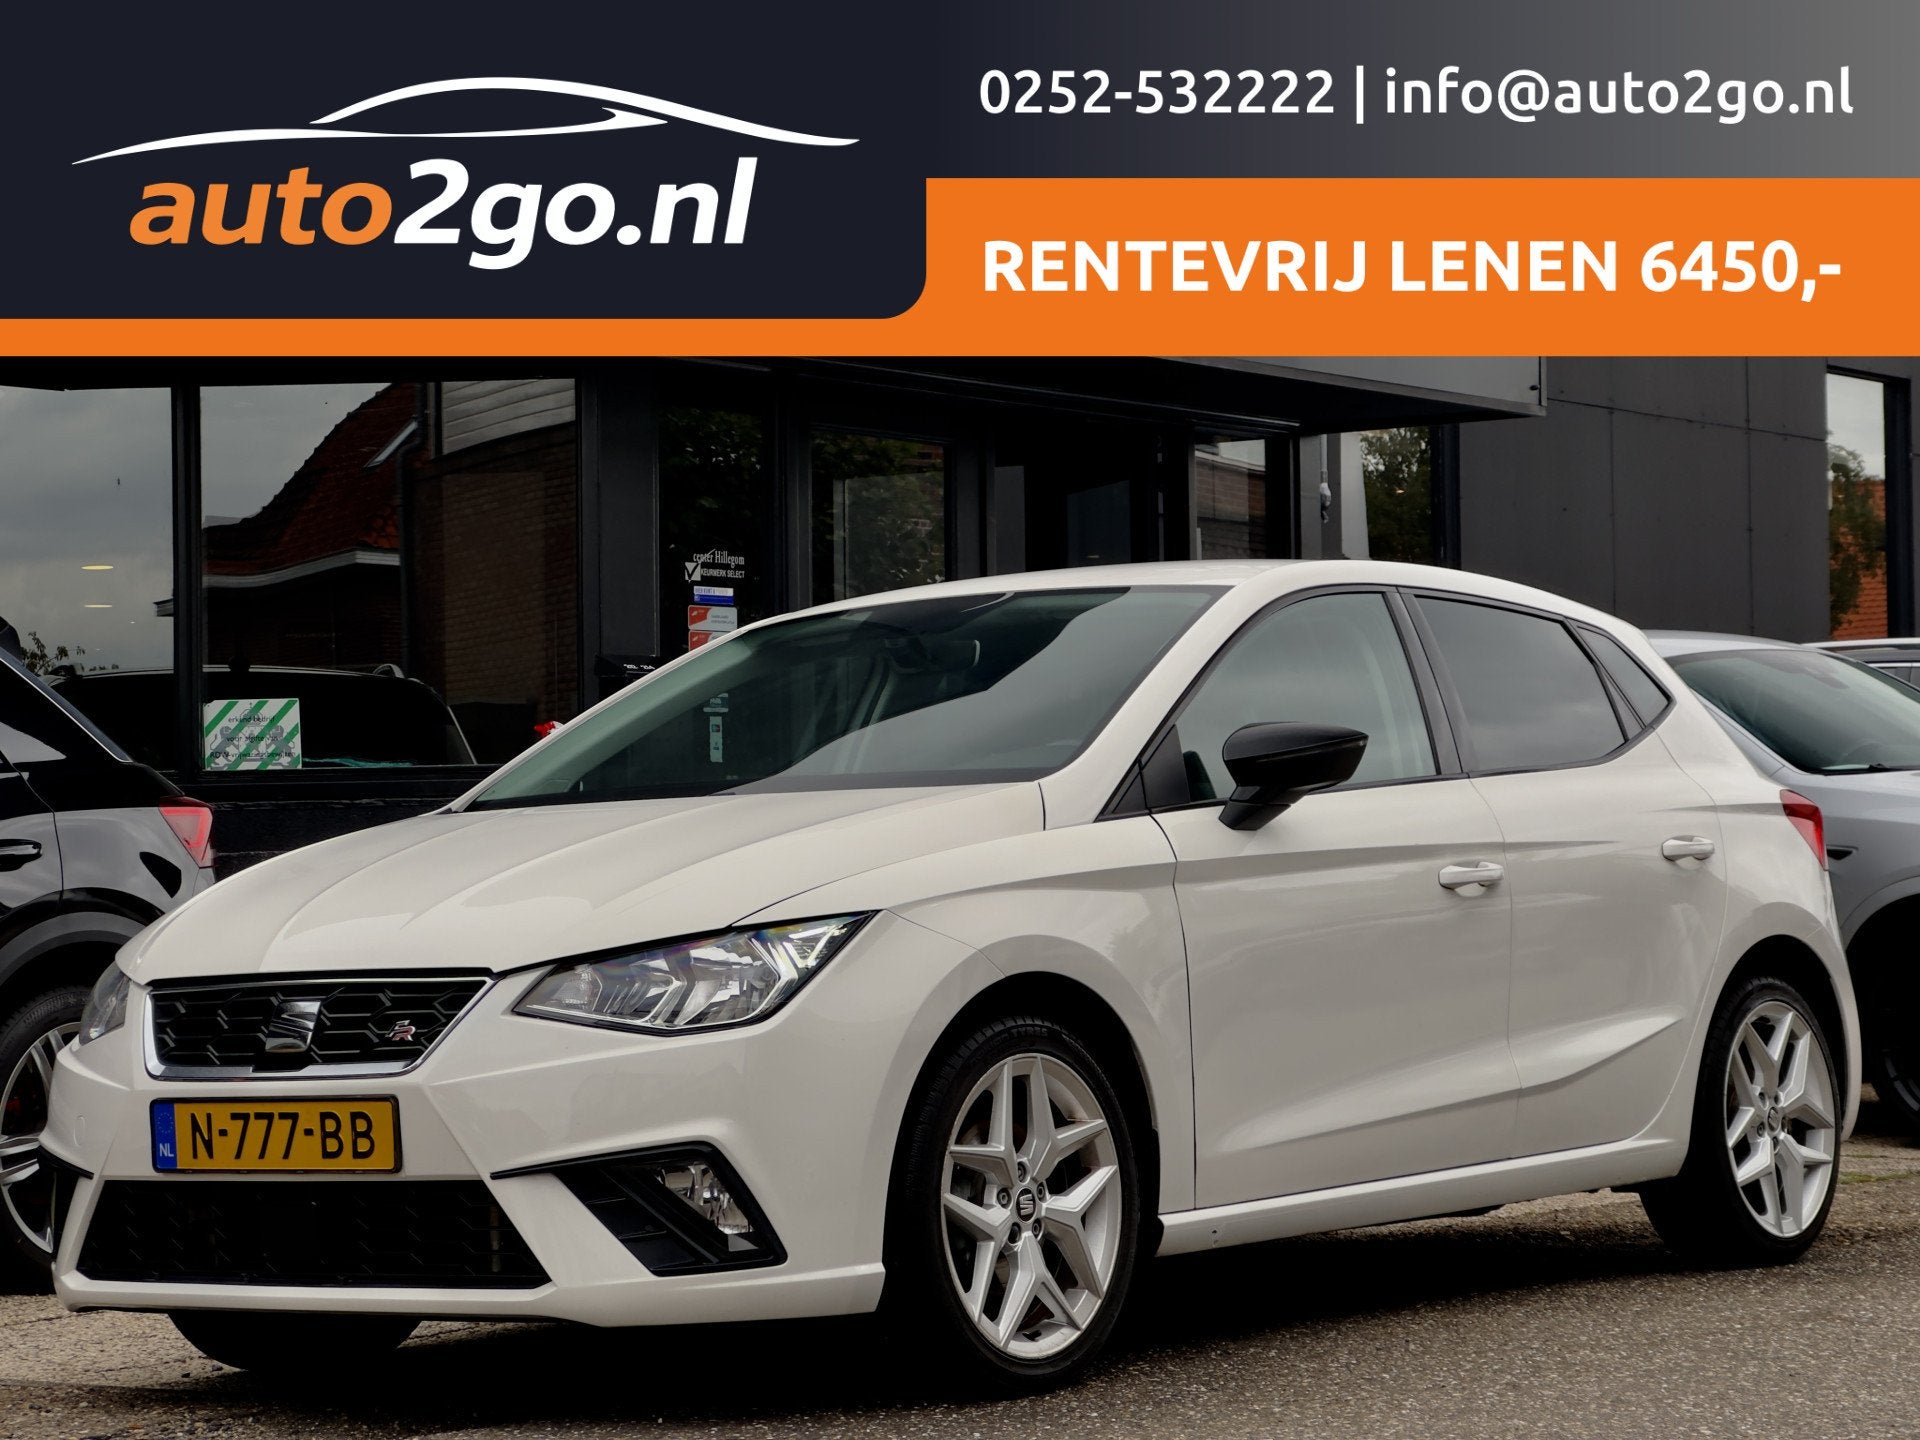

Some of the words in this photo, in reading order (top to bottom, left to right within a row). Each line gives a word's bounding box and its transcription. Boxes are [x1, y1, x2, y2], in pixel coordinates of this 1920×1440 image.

[714, 550, 745, 568] Hillegom
[727, 569, 745, 579] SELECT
[190, 1110, 376, 1160] N-777-BB
[159, 1143, 175, 1158] NL
